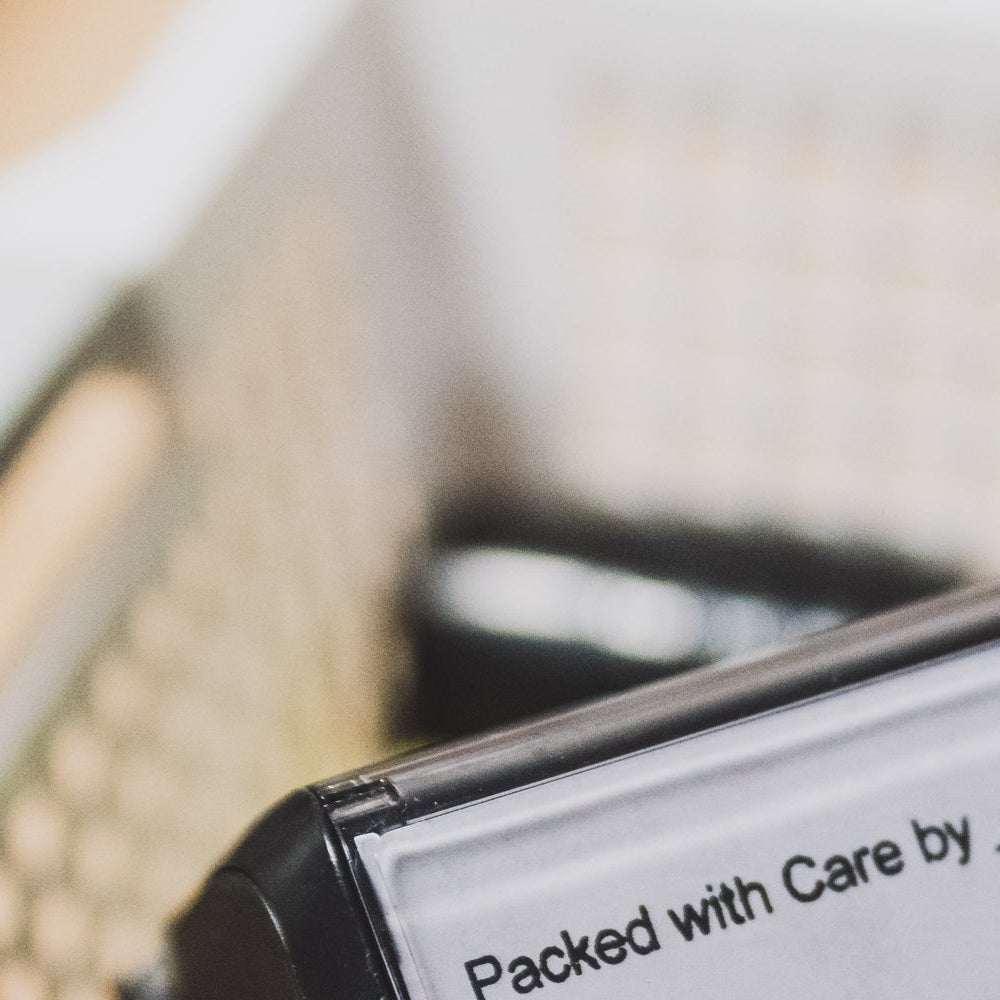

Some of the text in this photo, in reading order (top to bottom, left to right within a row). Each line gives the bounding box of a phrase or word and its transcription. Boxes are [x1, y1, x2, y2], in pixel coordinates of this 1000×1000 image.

[667, 876, 774, 942] with
[782, 840, 905, 903] Care
[911, 817, 972, 866] by
